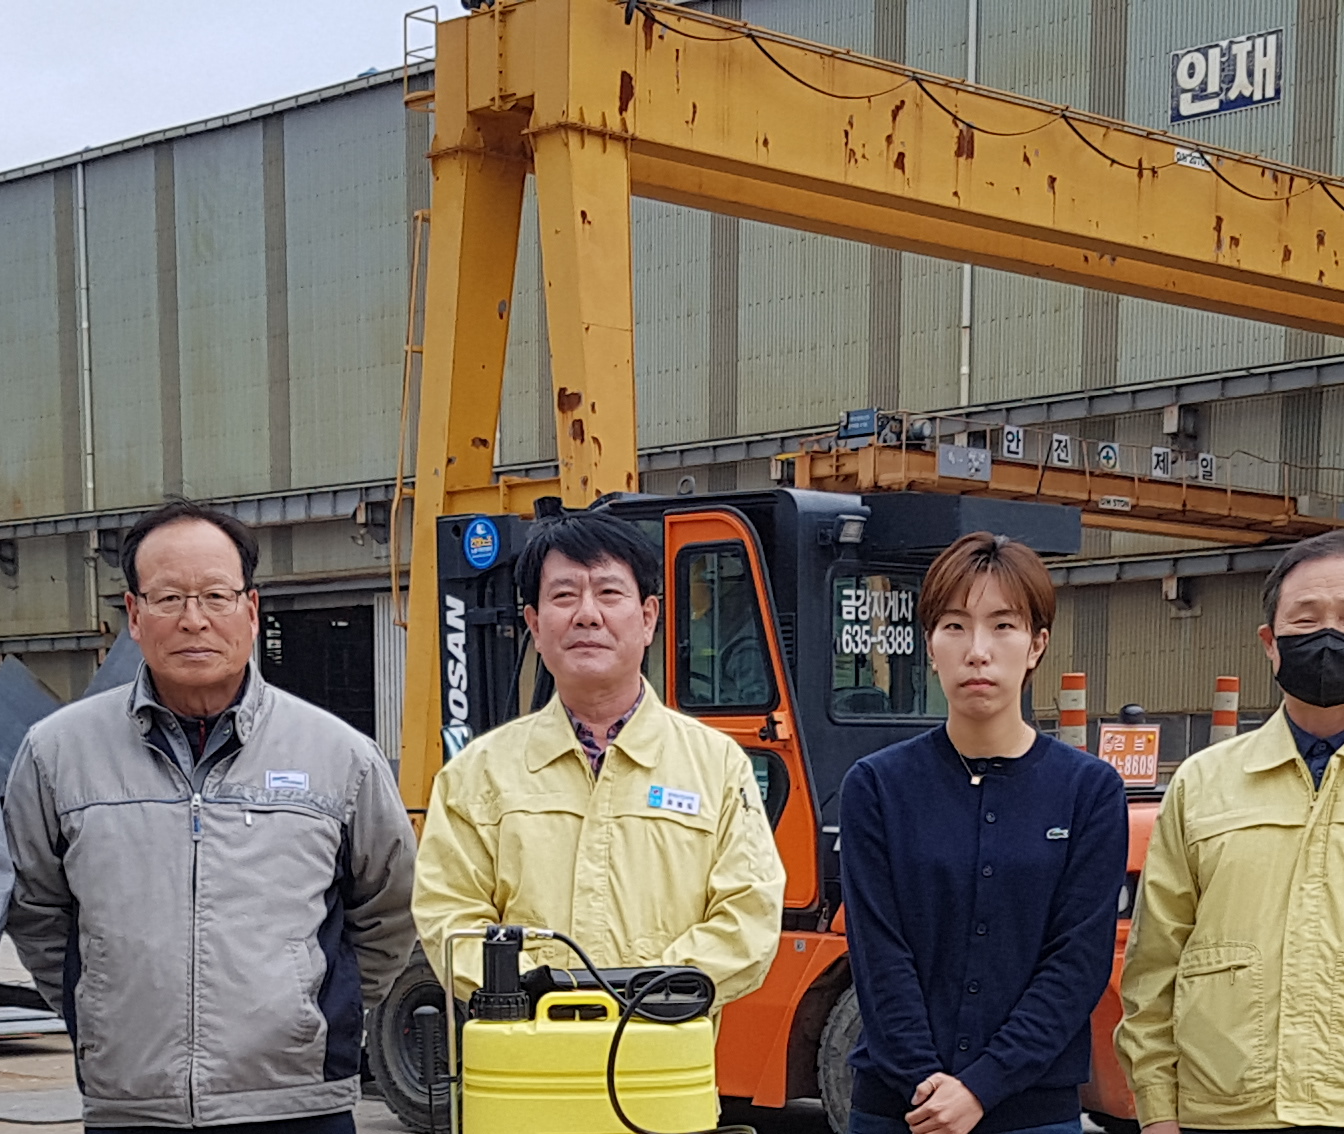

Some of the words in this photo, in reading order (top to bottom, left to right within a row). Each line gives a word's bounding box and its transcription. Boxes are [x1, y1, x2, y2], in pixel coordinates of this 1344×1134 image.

[1175, 33, 1278, 117] 인재
[841, 589, 914, 622] 금강지게차
[842, 624, 914, 655] 635-5388
